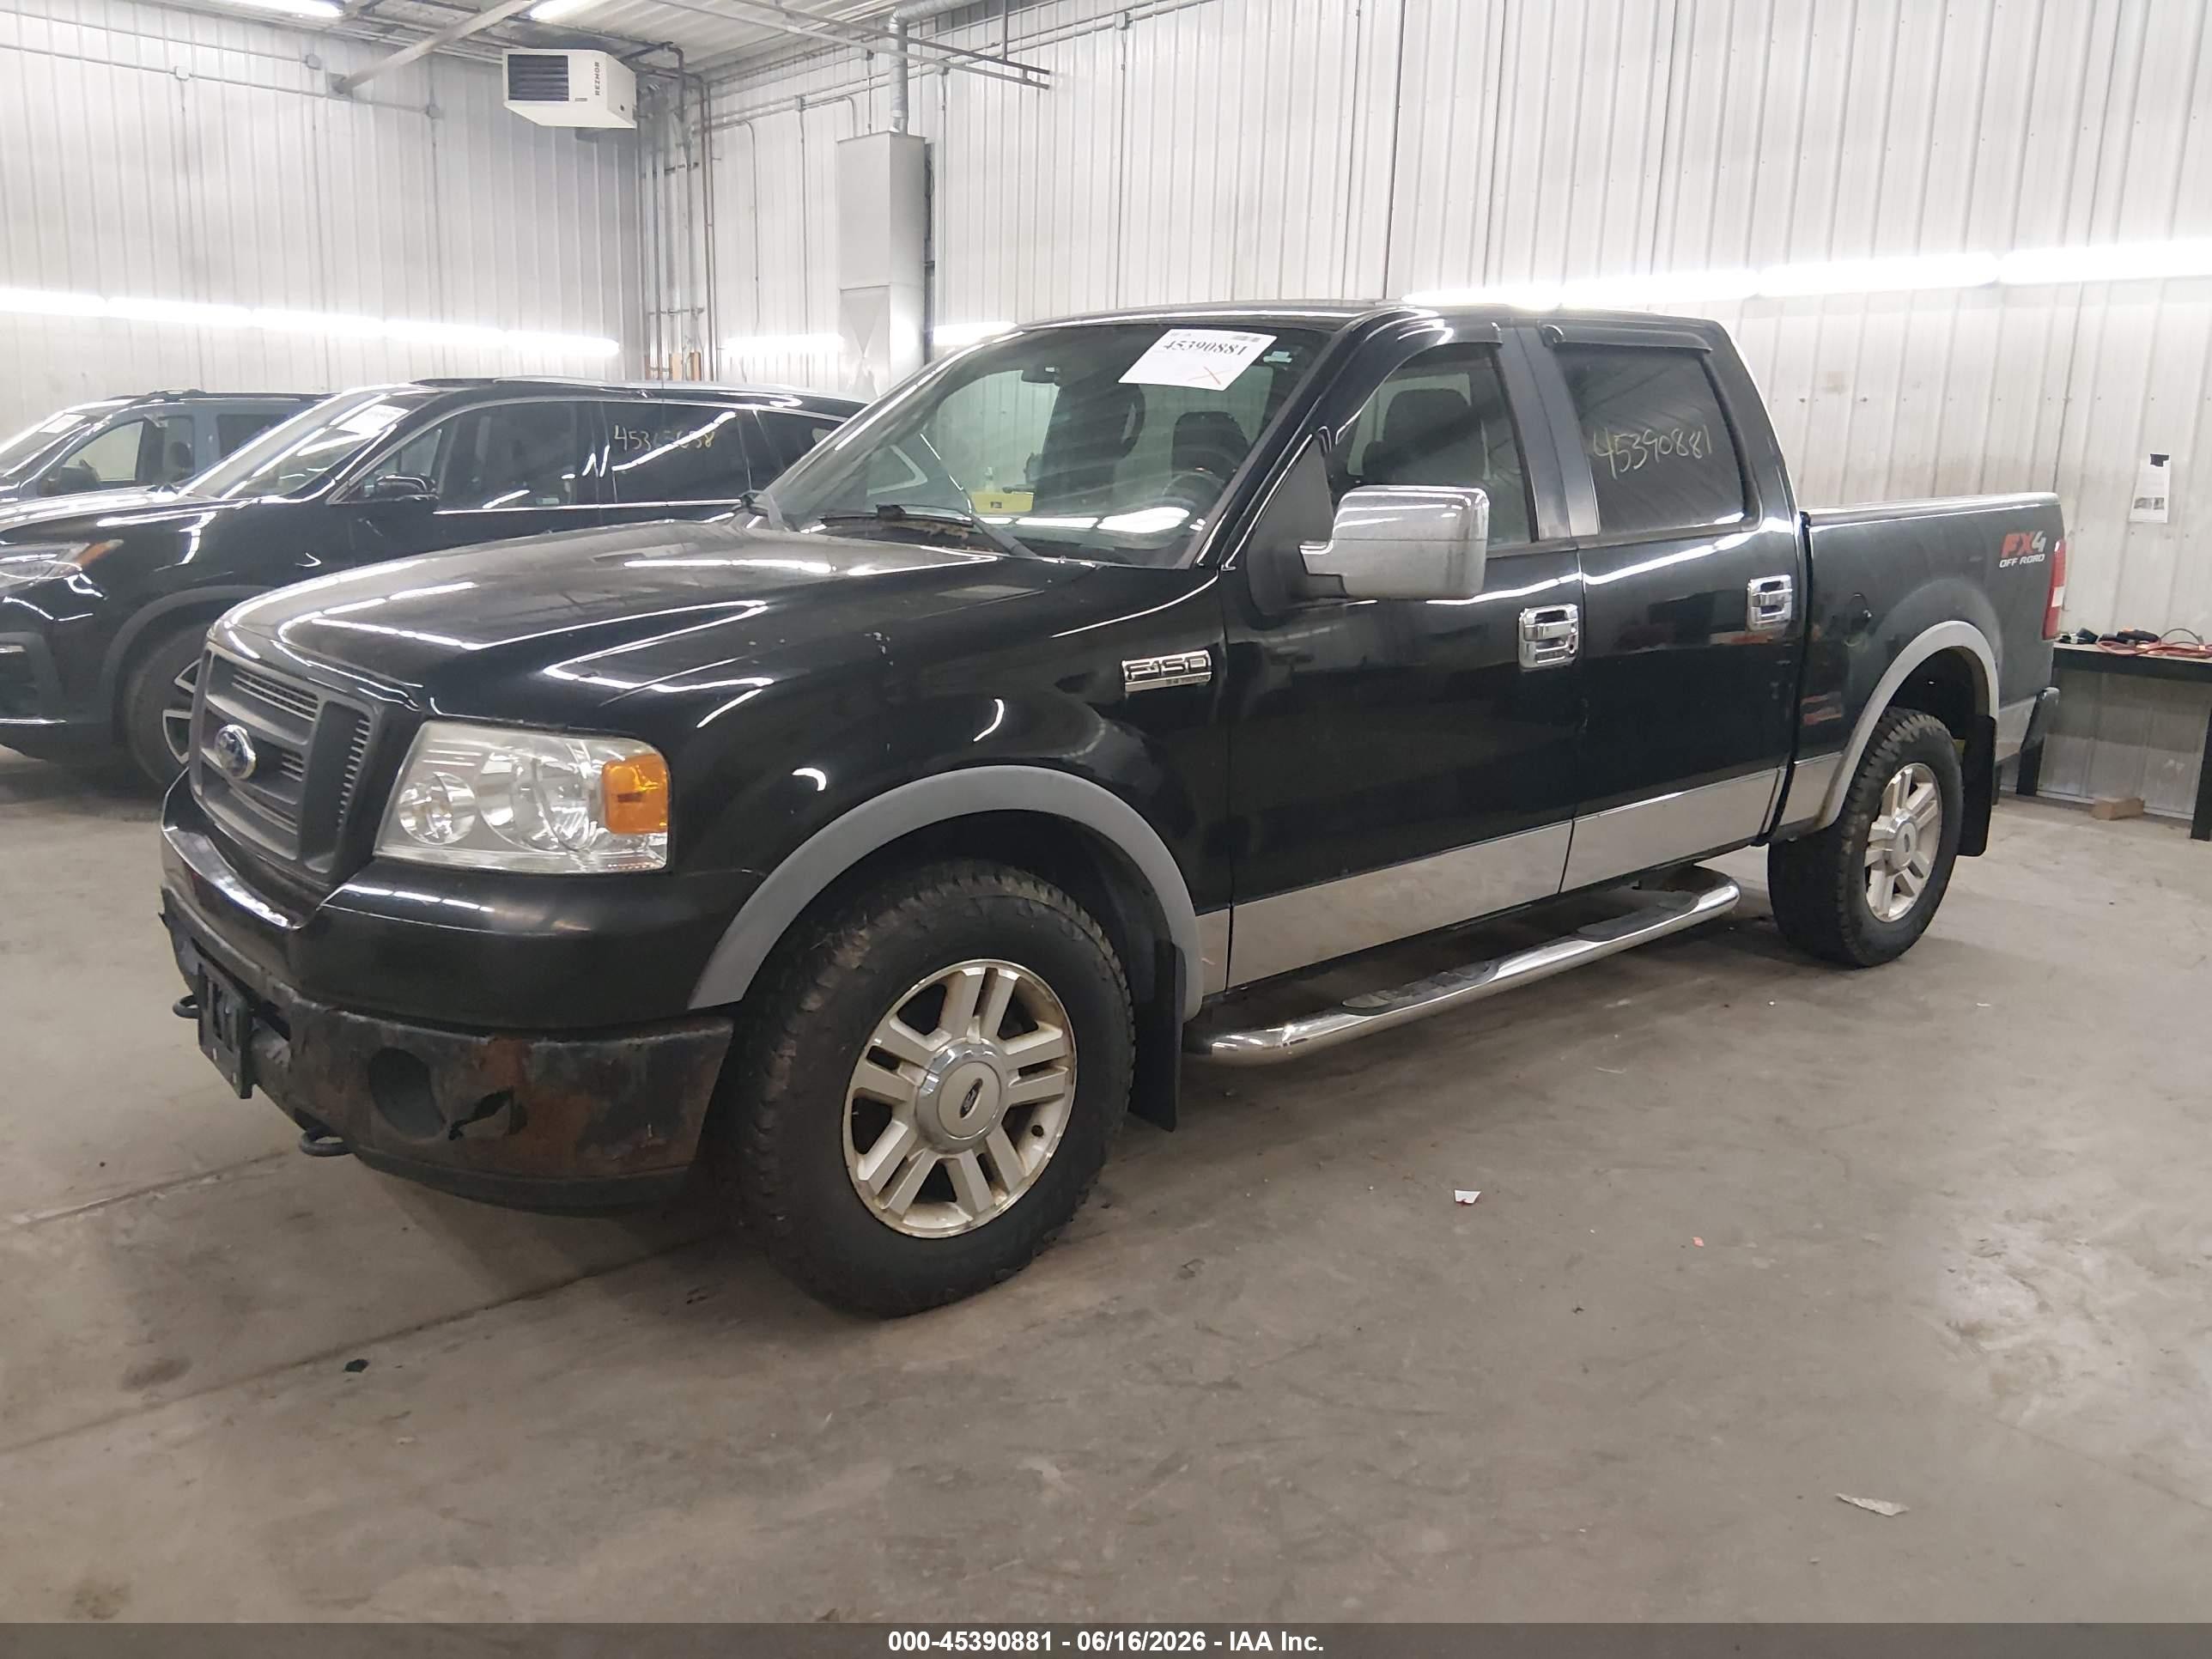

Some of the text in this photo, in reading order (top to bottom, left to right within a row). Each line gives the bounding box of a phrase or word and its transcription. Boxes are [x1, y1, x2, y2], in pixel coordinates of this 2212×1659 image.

[1164, 340, 1248, 356] 45390881
[1593, 424, 1712, 480] 45390881
[2001, 530, 2046, 558] FX4
[1999, 554, 2045, 568] OFF ROAD
